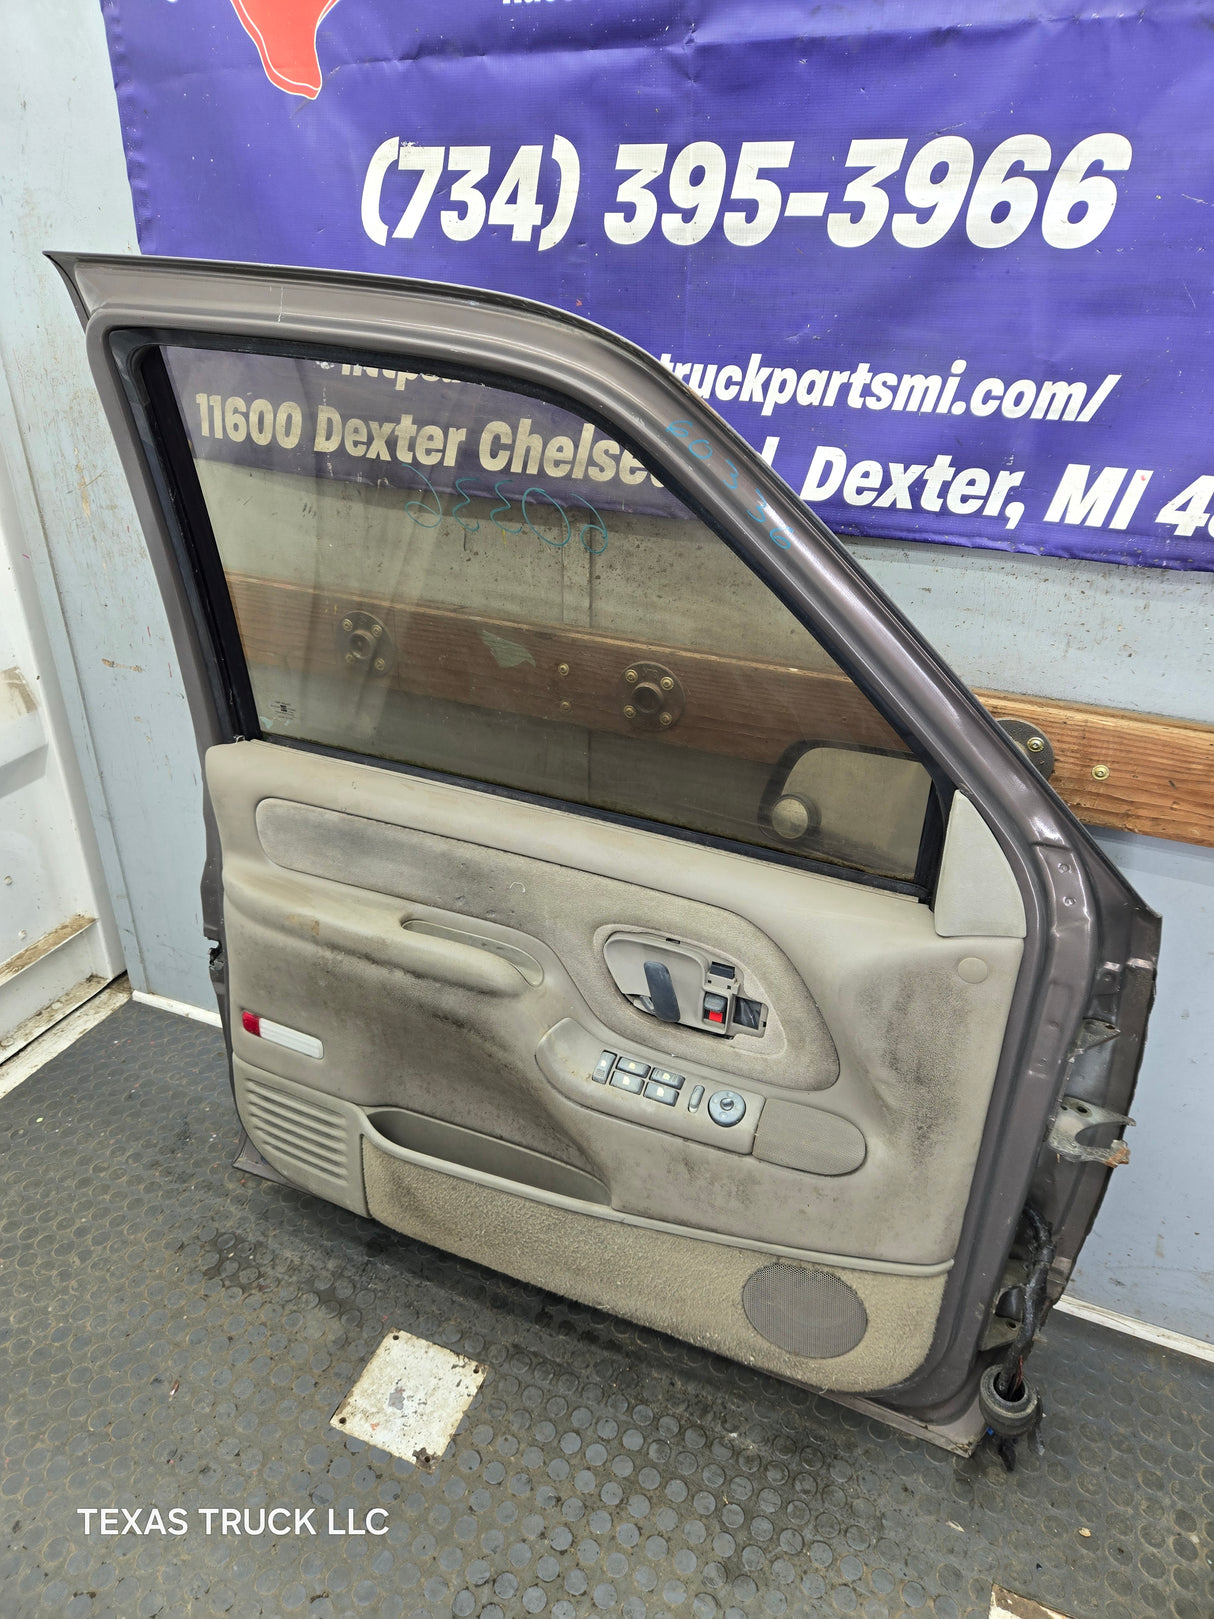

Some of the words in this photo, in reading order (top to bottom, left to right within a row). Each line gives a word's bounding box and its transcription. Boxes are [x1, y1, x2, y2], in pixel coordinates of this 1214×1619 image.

[361, 134, 580, 252] (734)
[604, 133, 1133, 249] 395-3966
[196, 393, 303, 449] 11600
[314, 405, 466, 467] Dexter
[795, 446, 1025, 530] Dexter,
[1043, 464, 1154, 530] MI
[1155, 475, 1214, 538] 4
